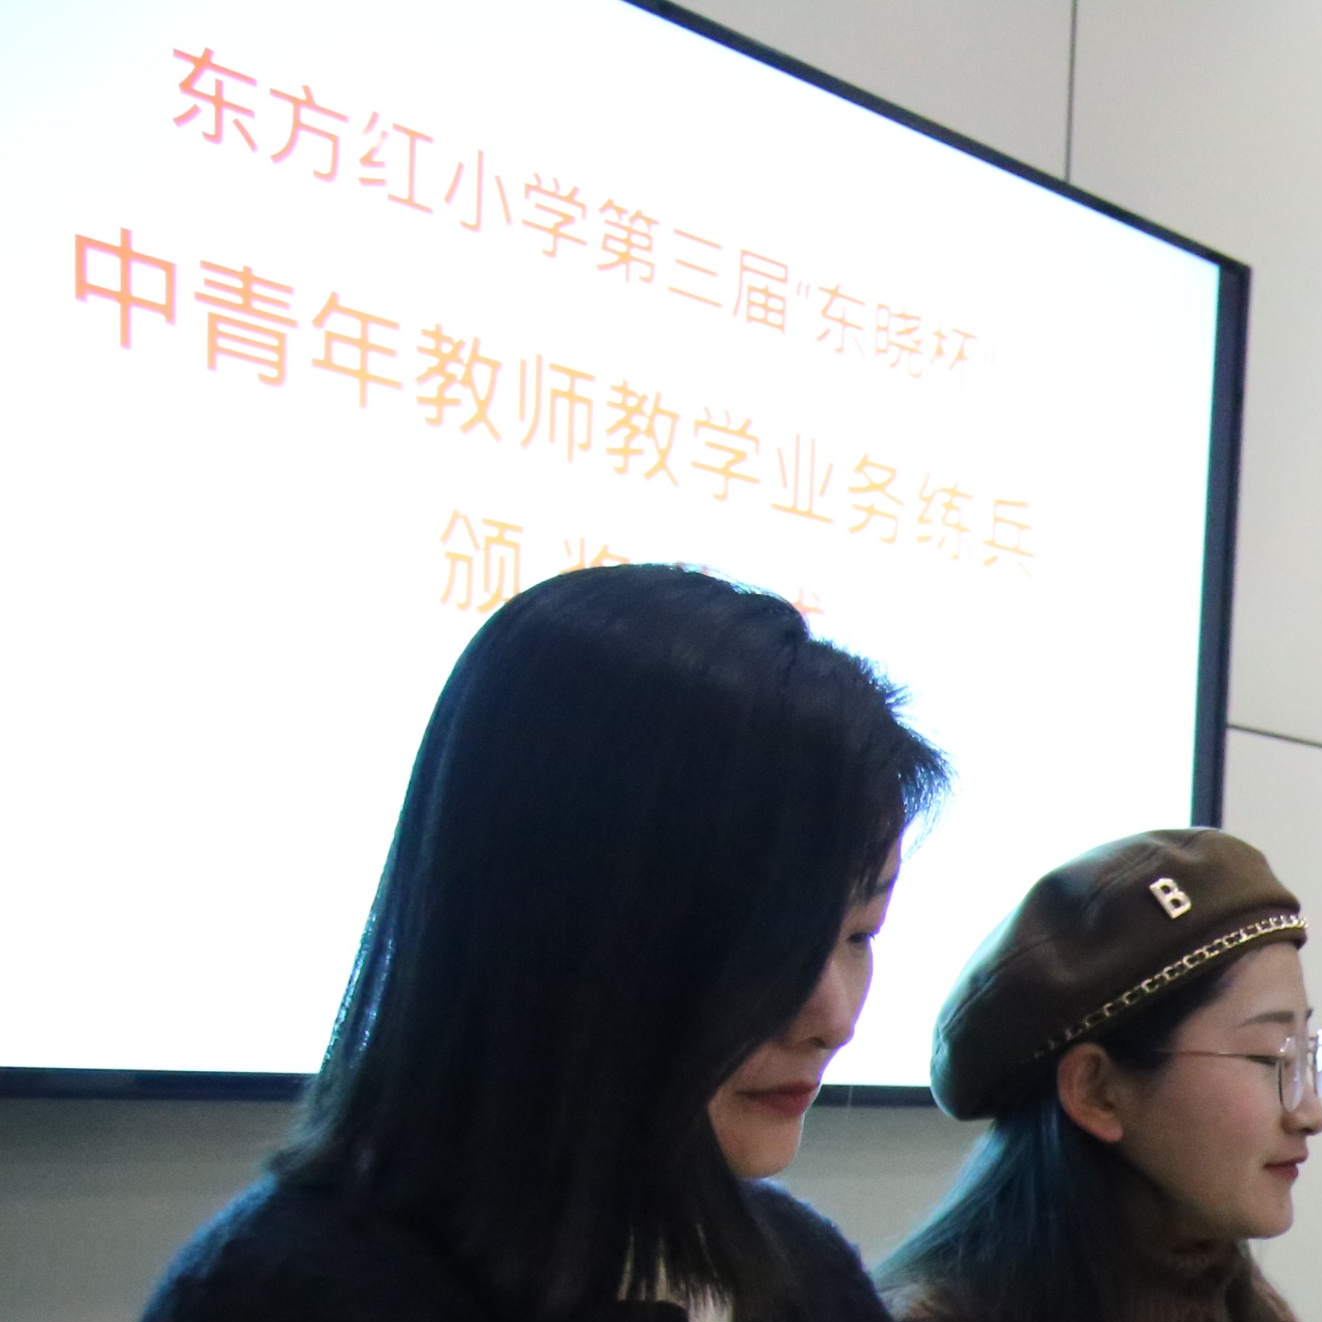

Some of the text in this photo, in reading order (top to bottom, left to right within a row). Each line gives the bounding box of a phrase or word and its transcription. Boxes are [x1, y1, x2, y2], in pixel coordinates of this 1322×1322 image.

[74, 226, 1036, 578] 中青年教师教学业务练兵
[1149, 878, 1192, 919] B
